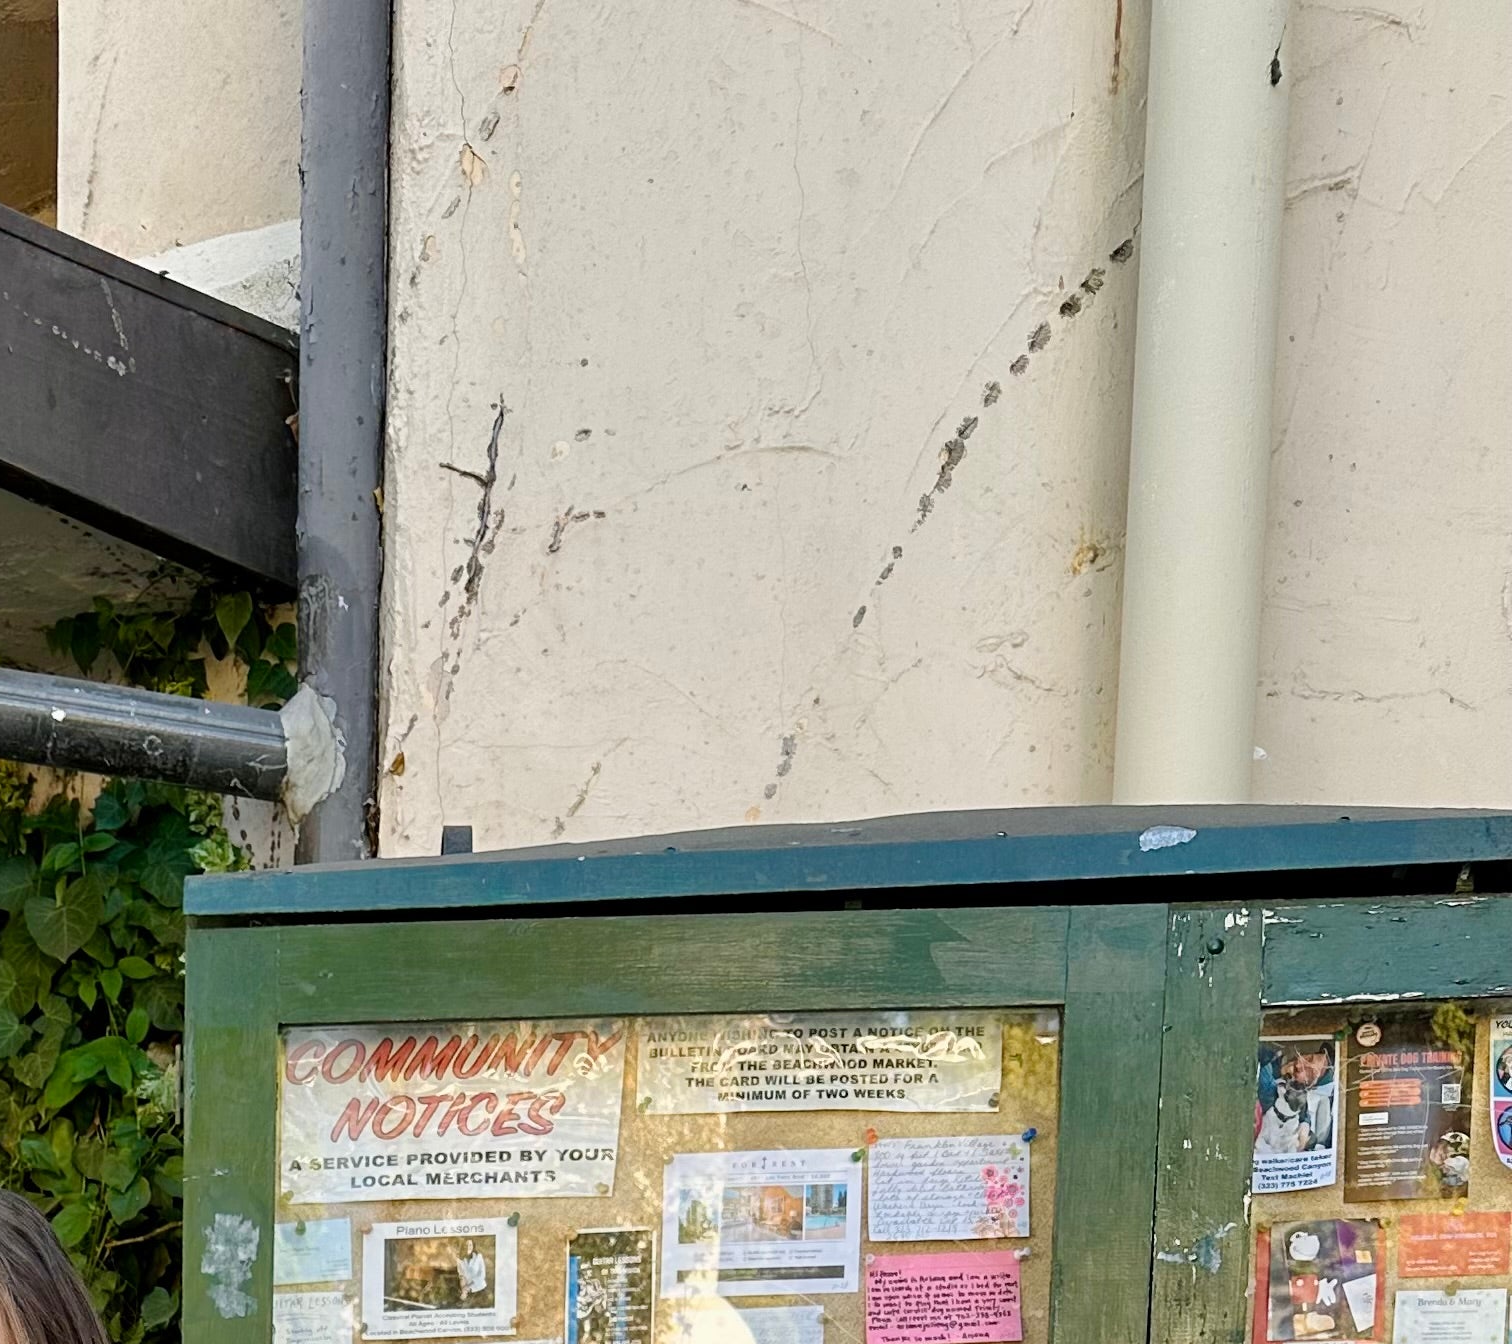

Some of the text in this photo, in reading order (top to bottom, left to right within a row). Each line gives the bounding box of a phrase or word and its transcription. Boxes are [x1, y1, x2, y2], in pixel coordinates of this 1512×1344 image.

[647, 1028, 715, 1043] ANYONE
[784, 1028, 803, 1039] TO
[809, 1028, 847, 1039] POST
[853, 1028, 863, 1037] A
[868, 1026, 923, 1037] NOTICE
[956, 1026, 984, 1037] THE
[285, 1030, 622, 1085] COMMUNITY
[649, 1046, 722, 1058] BULLETIN
[730, 1044, 777, 1057] OARD
[784, 1043, 814, 1055] MAY
[739, 1060, 767, 1071] THE
[873, 1058, 938, 1069] MARKET.
[1401, 1053, 1418, 1064] DOG
[686, 1073, 938, 1088] THE CARD WILL BE POSTED FOR A
[718, 1088, 906, 1101] MINIMUM OF TWO WEEKS
[331, 1092, 566, 1142] NOTICES
[289, 1149, 614, 1171] A SERVICE PROVIDED BY YOUR
[351, 1170, 556, 1188] LOCAL MERCHANTS
[396, 1226, 430, 1235] Piano
